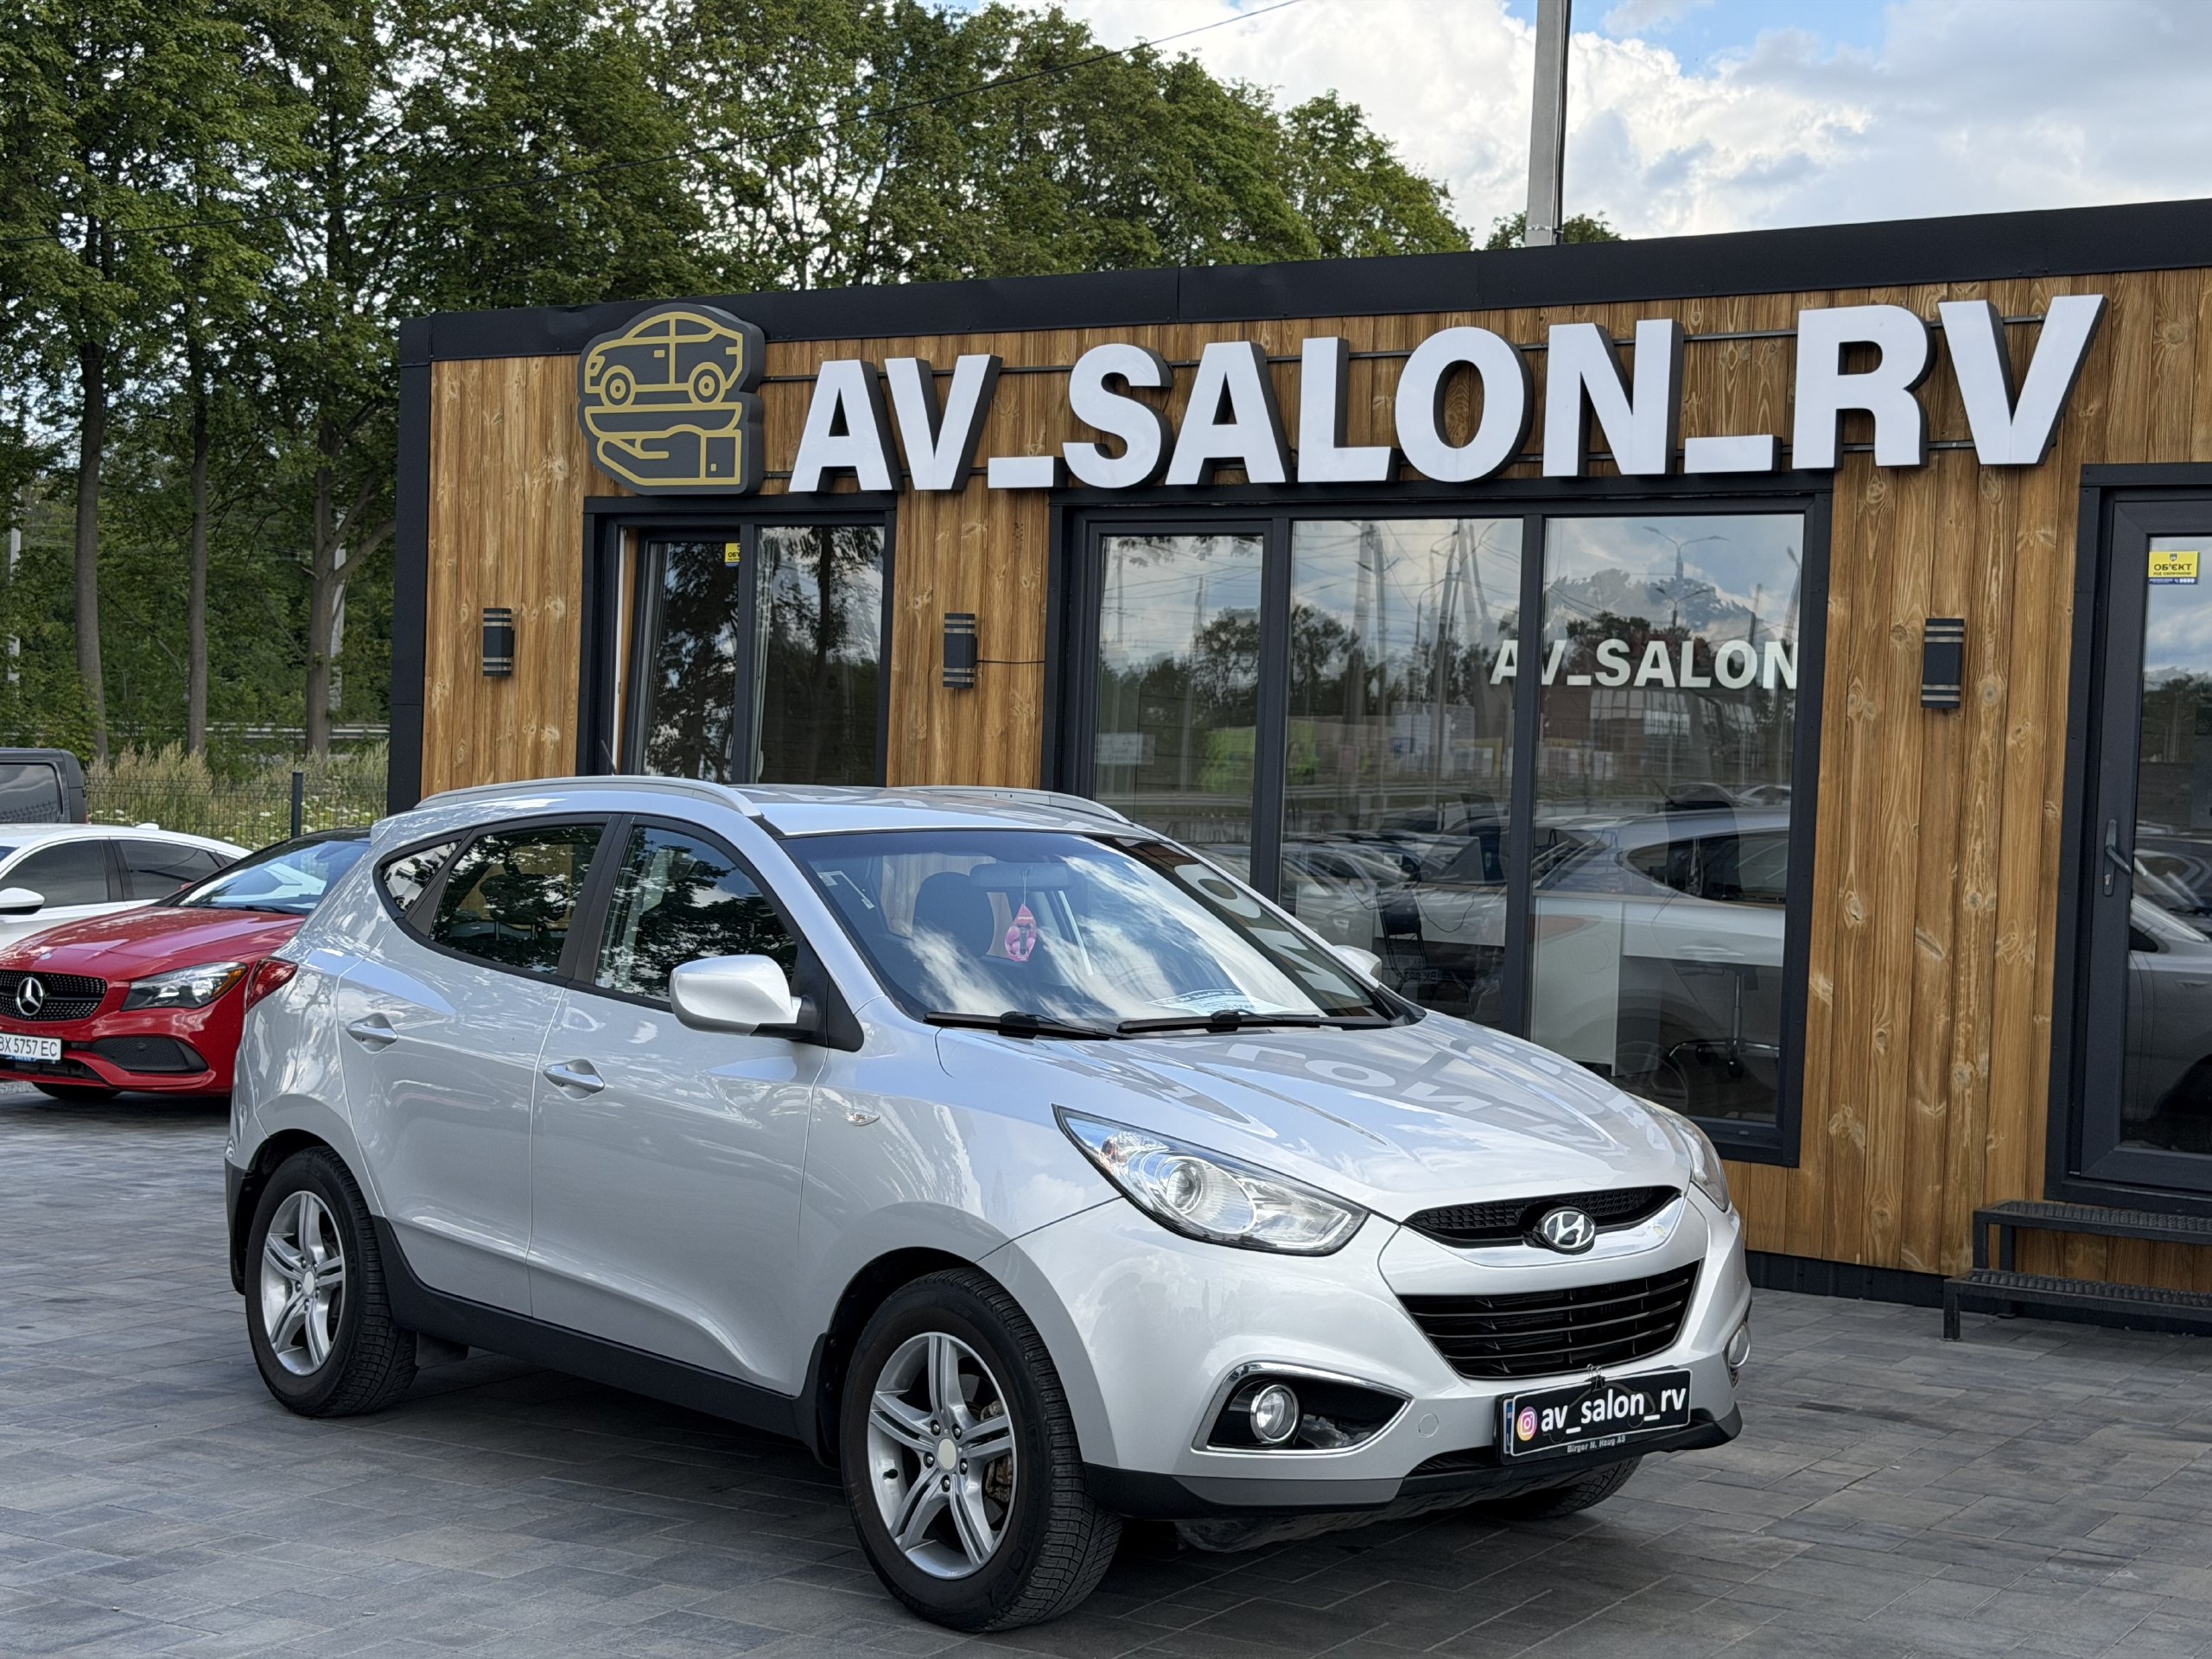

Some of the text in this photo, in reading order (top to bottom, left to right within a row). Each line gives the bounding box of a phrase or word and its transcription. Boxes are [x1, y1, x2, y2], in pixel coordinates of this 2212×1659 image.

[789, 295, 2107, 493] AV_SALON_RV
[2153, 563, 2192, 571] ОБ'ЄКТ
[14, 1038, 38, 1055] 5757
[41, 1040, 57, 1057] EC
[1541, 1388, 1687, 1434] av_salon_rv
